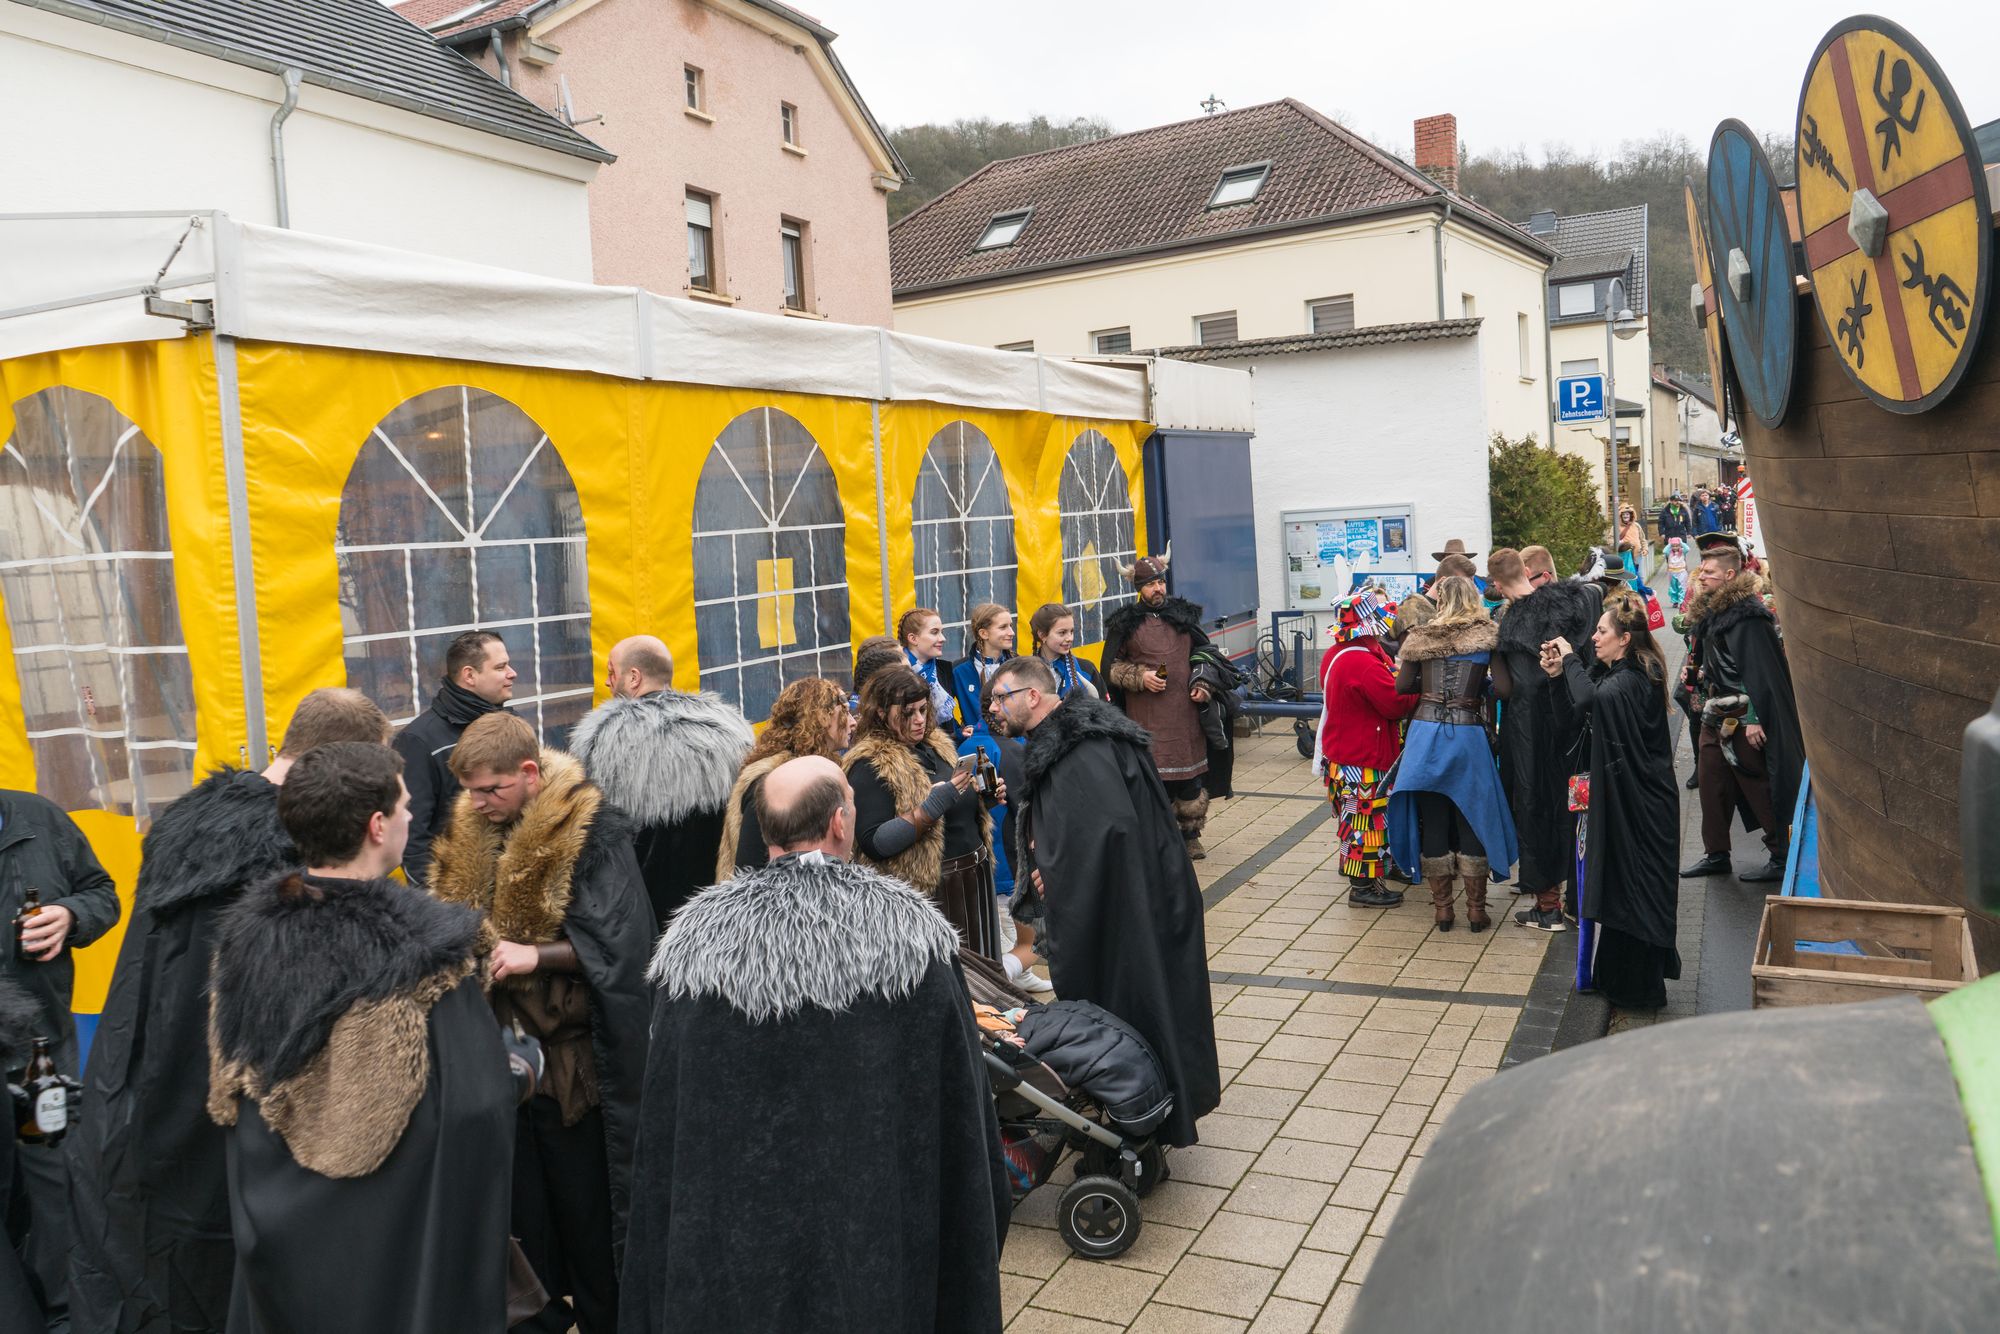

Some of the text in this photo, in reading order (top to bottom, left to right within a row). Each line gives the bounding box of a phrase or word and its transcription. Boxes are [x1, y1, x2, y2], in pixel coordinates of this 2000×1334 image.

[1571, 381, 1591, 408] P
[1561, 409, 1603, 419] Zehntscheune
[1746, 503, 1754, 538] WEBER
